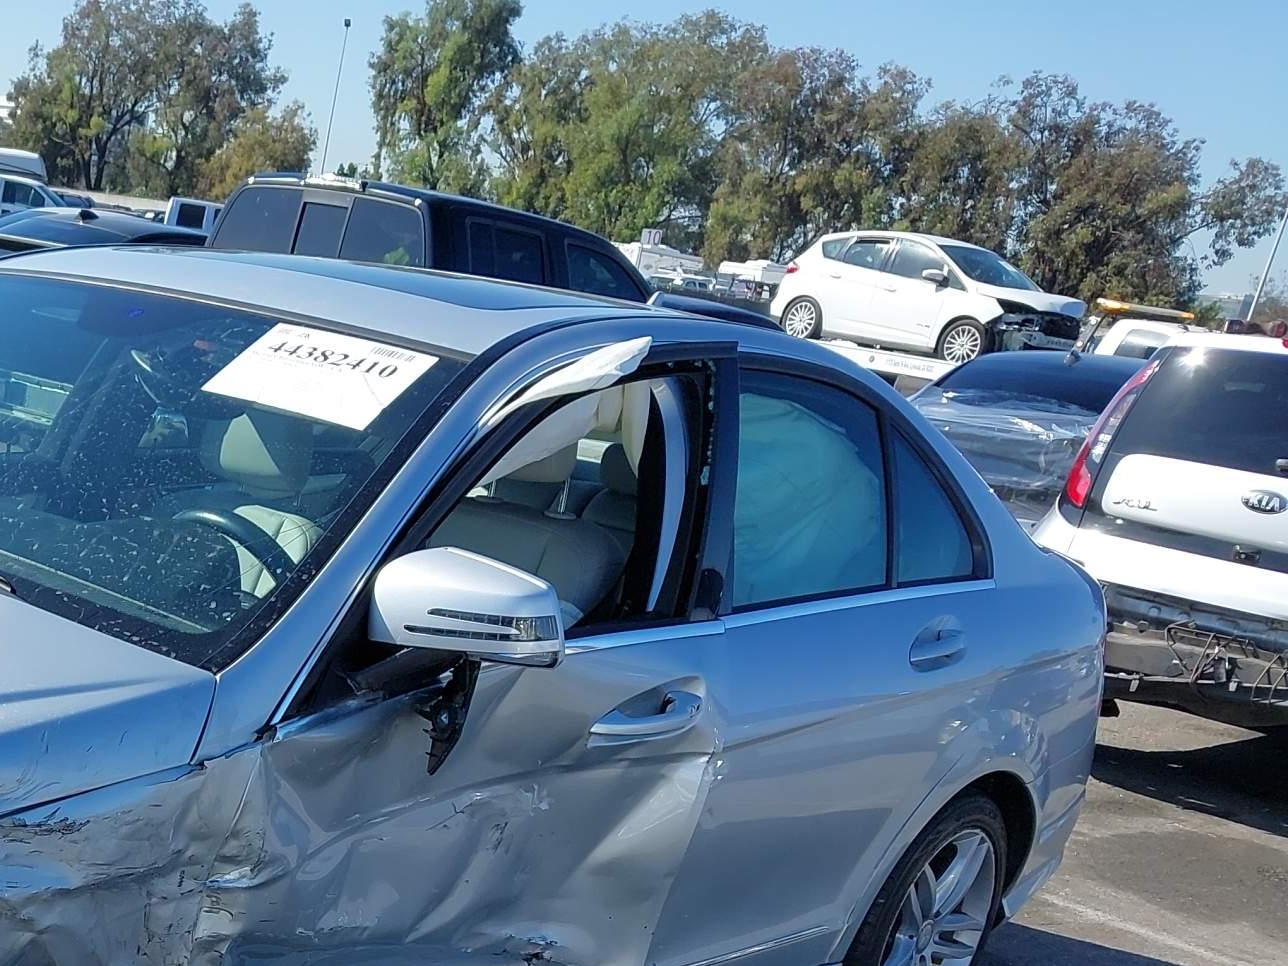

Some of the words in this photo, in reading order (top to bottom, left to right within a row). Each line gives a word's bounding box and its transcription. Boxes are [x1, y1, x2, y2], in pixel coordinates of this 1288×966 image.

[647, 230, 662, 246] 10
[267, 341, 399, 378] 44382410
[1247, 494, 1280, 512] KIA
